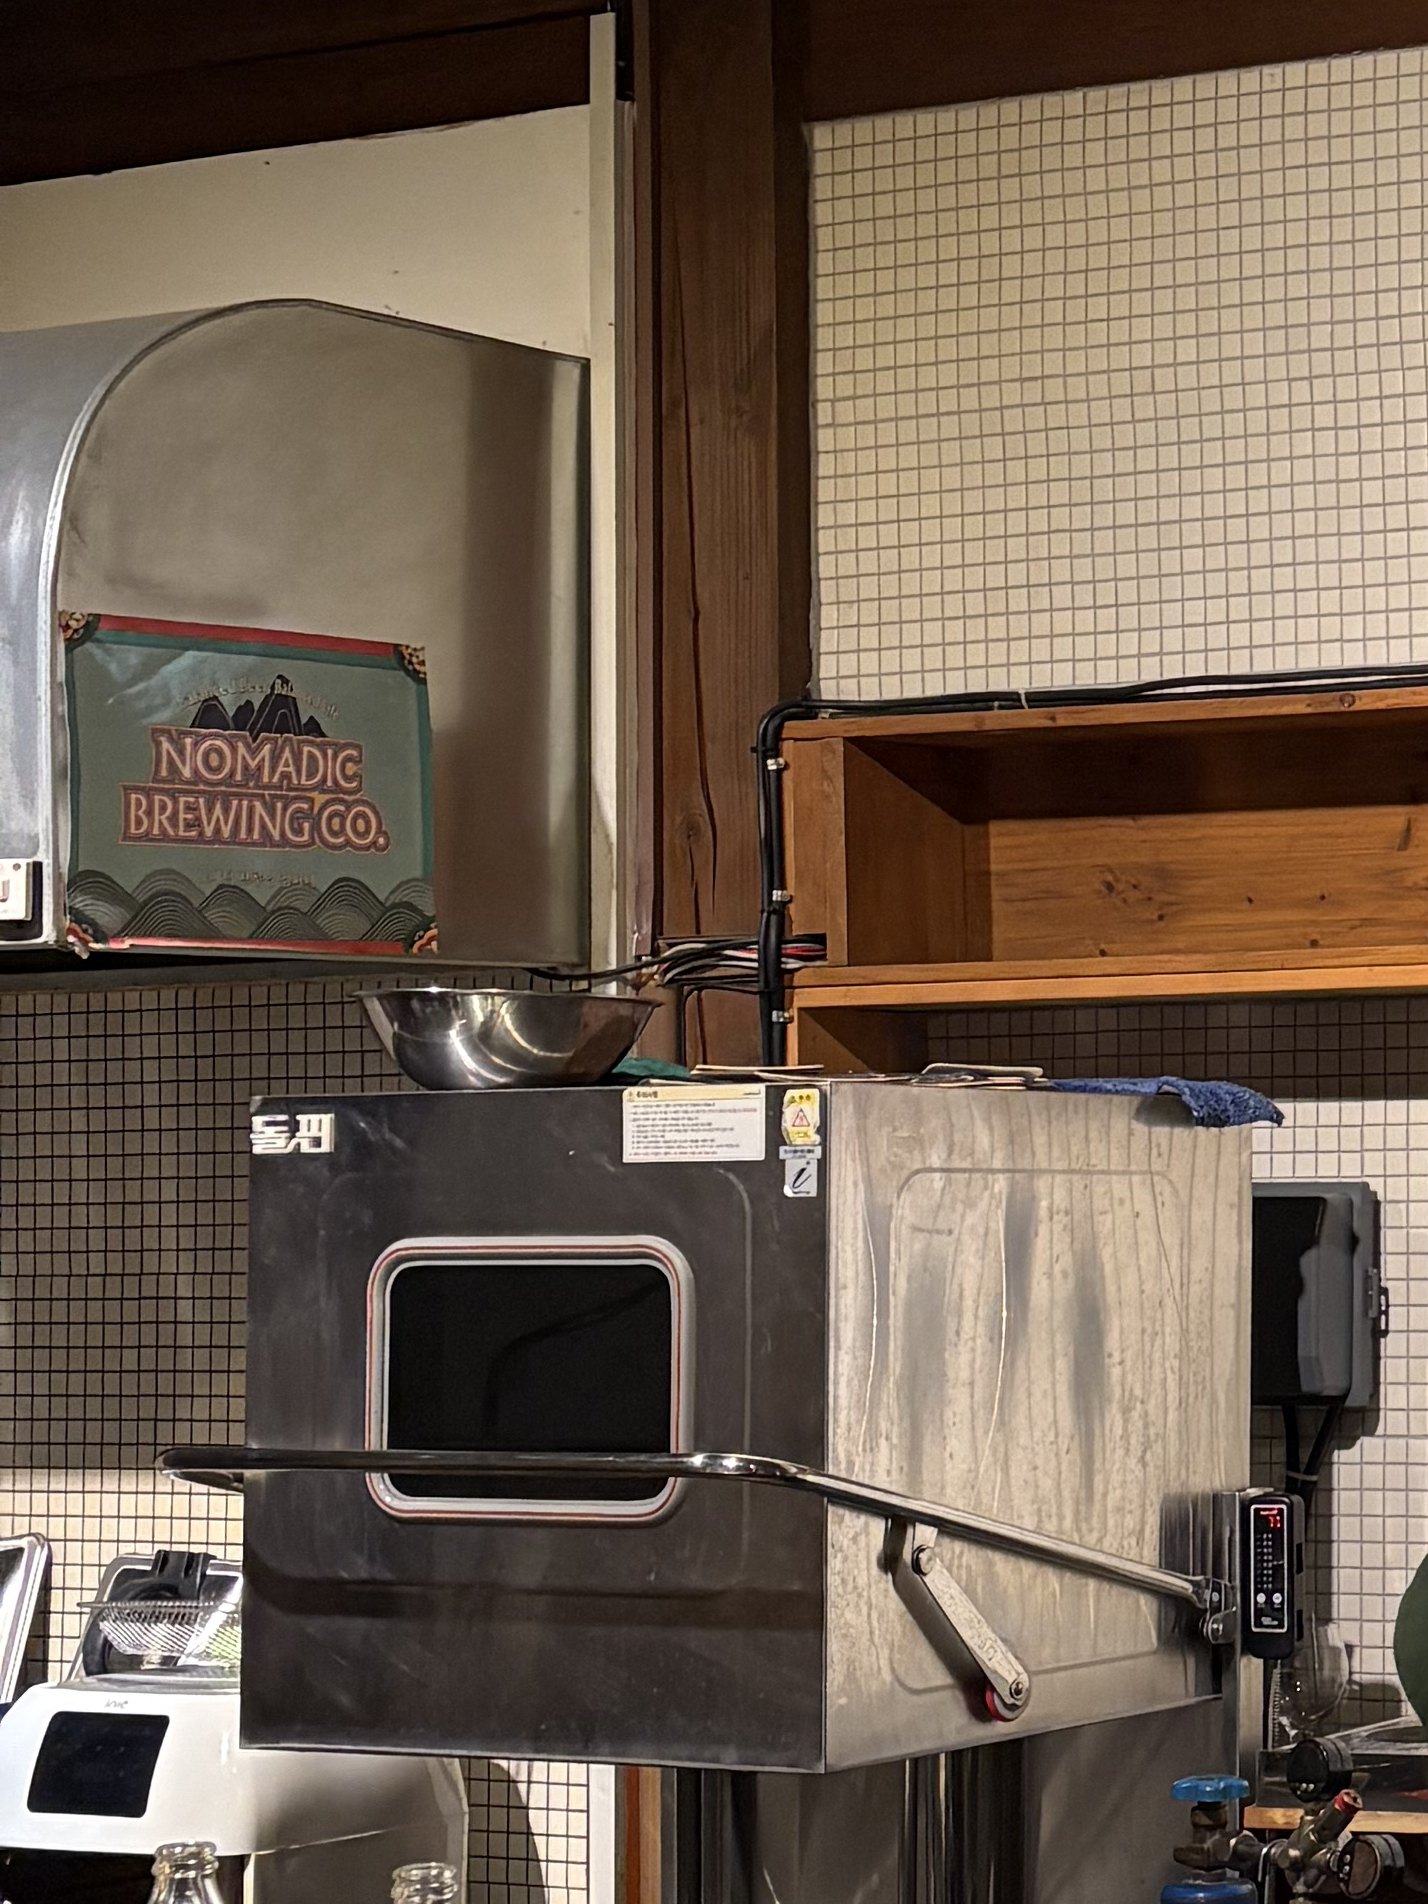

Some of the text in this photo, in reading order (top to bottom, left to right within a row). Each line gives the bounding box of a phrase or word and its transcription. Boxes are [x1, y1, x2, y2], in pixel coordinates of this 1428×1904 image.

[158, 734, 363, 790] NOMADIC
[129, 792, 386, 847] BREWING CO.
